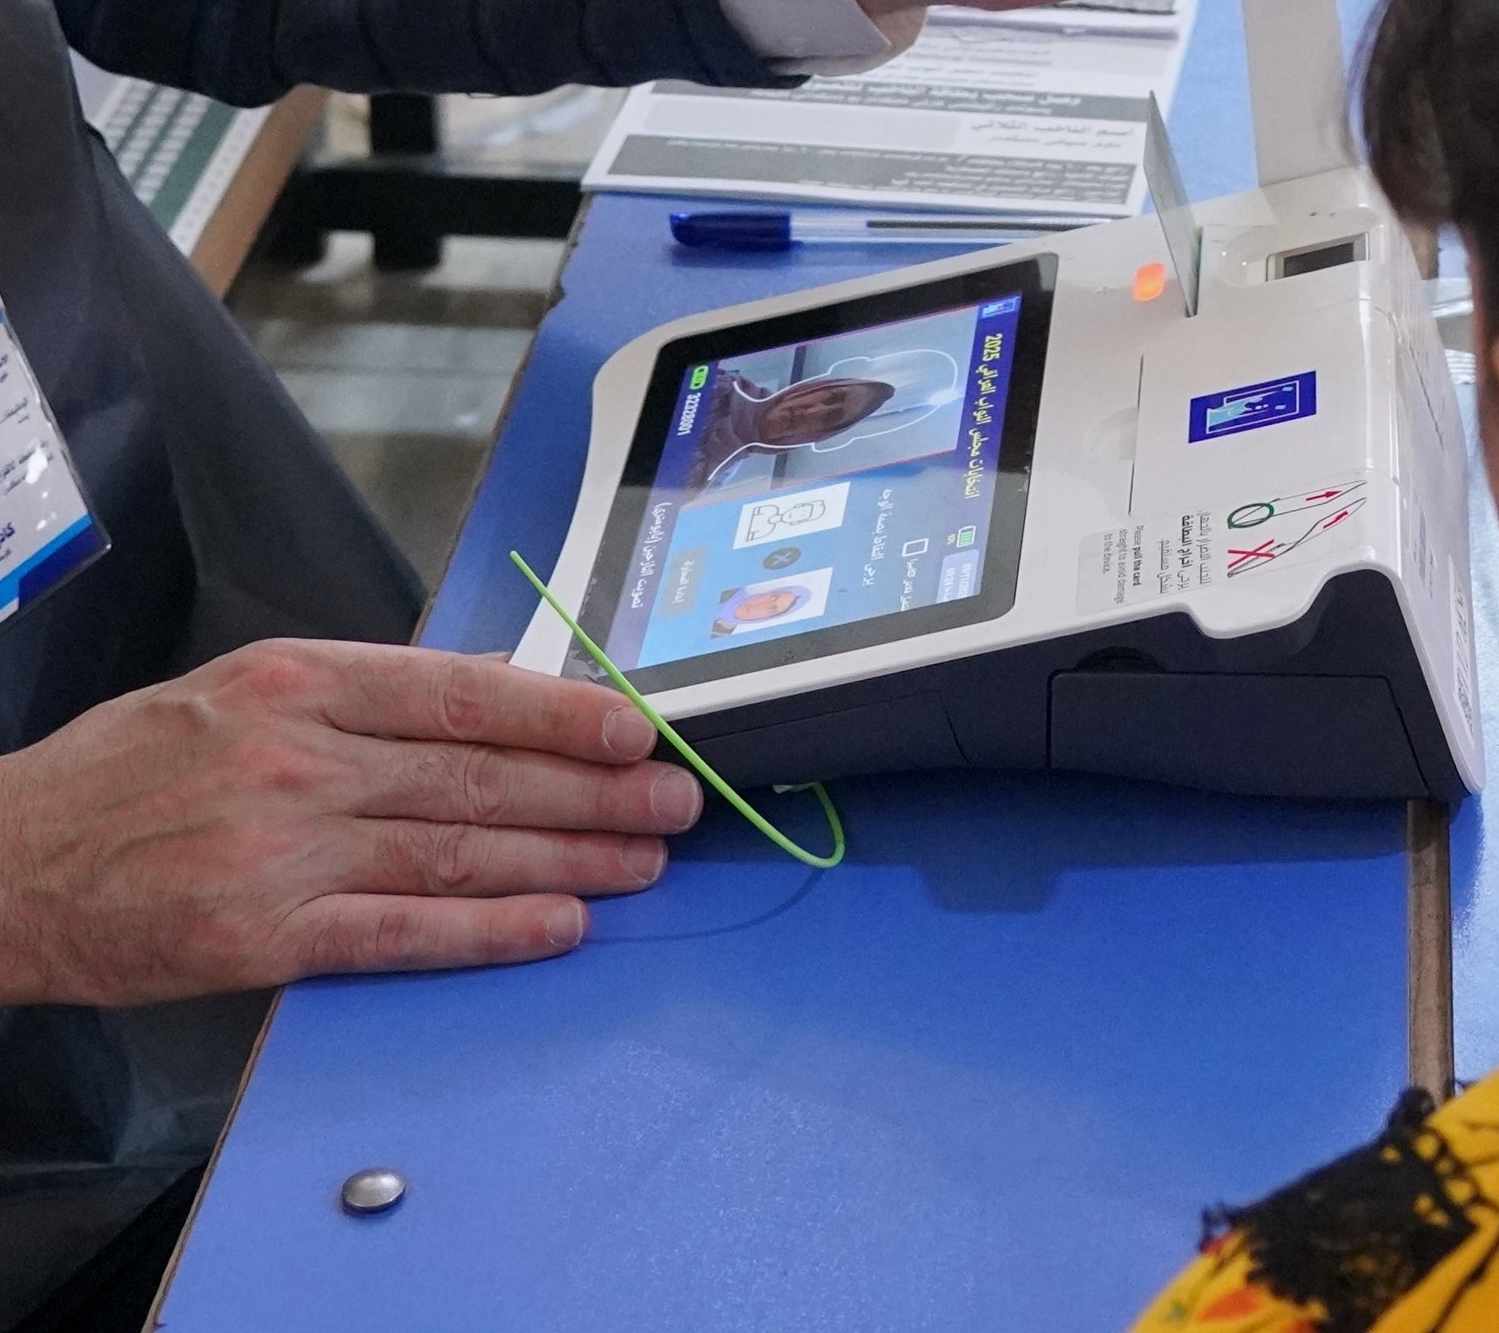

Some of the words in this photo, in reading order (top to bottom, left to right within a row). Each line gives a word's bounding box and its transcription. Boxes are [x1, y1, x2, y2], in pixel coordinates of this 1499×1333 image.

[982, 333, 1003, 361] 2025
[973, 364, 996, 393] العراقي
[973, 396, 993, 425] النواب
[967, 427, 988, 457] مجلس
[962, 459, 984, 499] انتخابات
[877, 488, 894, 510] الوجه
[872, 513, 893, 533] بصمة
[1179, 515, 1194, 546] البطاقة
[1103, 541, 1112, 552] the
[1104, 533, 1112, 541] to
[1116, 529, 1127, 553] straight
[1133, 525, 1144, 546] Please
[870, 536, 887, 561] التقاط
[1132, 547, 1144, 559] pull
[1157, 540, 1173, 570] مستقيم
[637, 545, 659, 577] النازحين
[1118, 561, 1126, 578] avoid
[1133, 560, 1143, 571] the
[862, 563, 876, 587] يرجى
[1133, 572, 1141, 586] card
[1157, 572, 1173, 594] بشكل
[1177, 570, 1190, 591] يرجى
[630, 577, 648, 609] تصويت
[1114, 579, 1126, 604] damage
